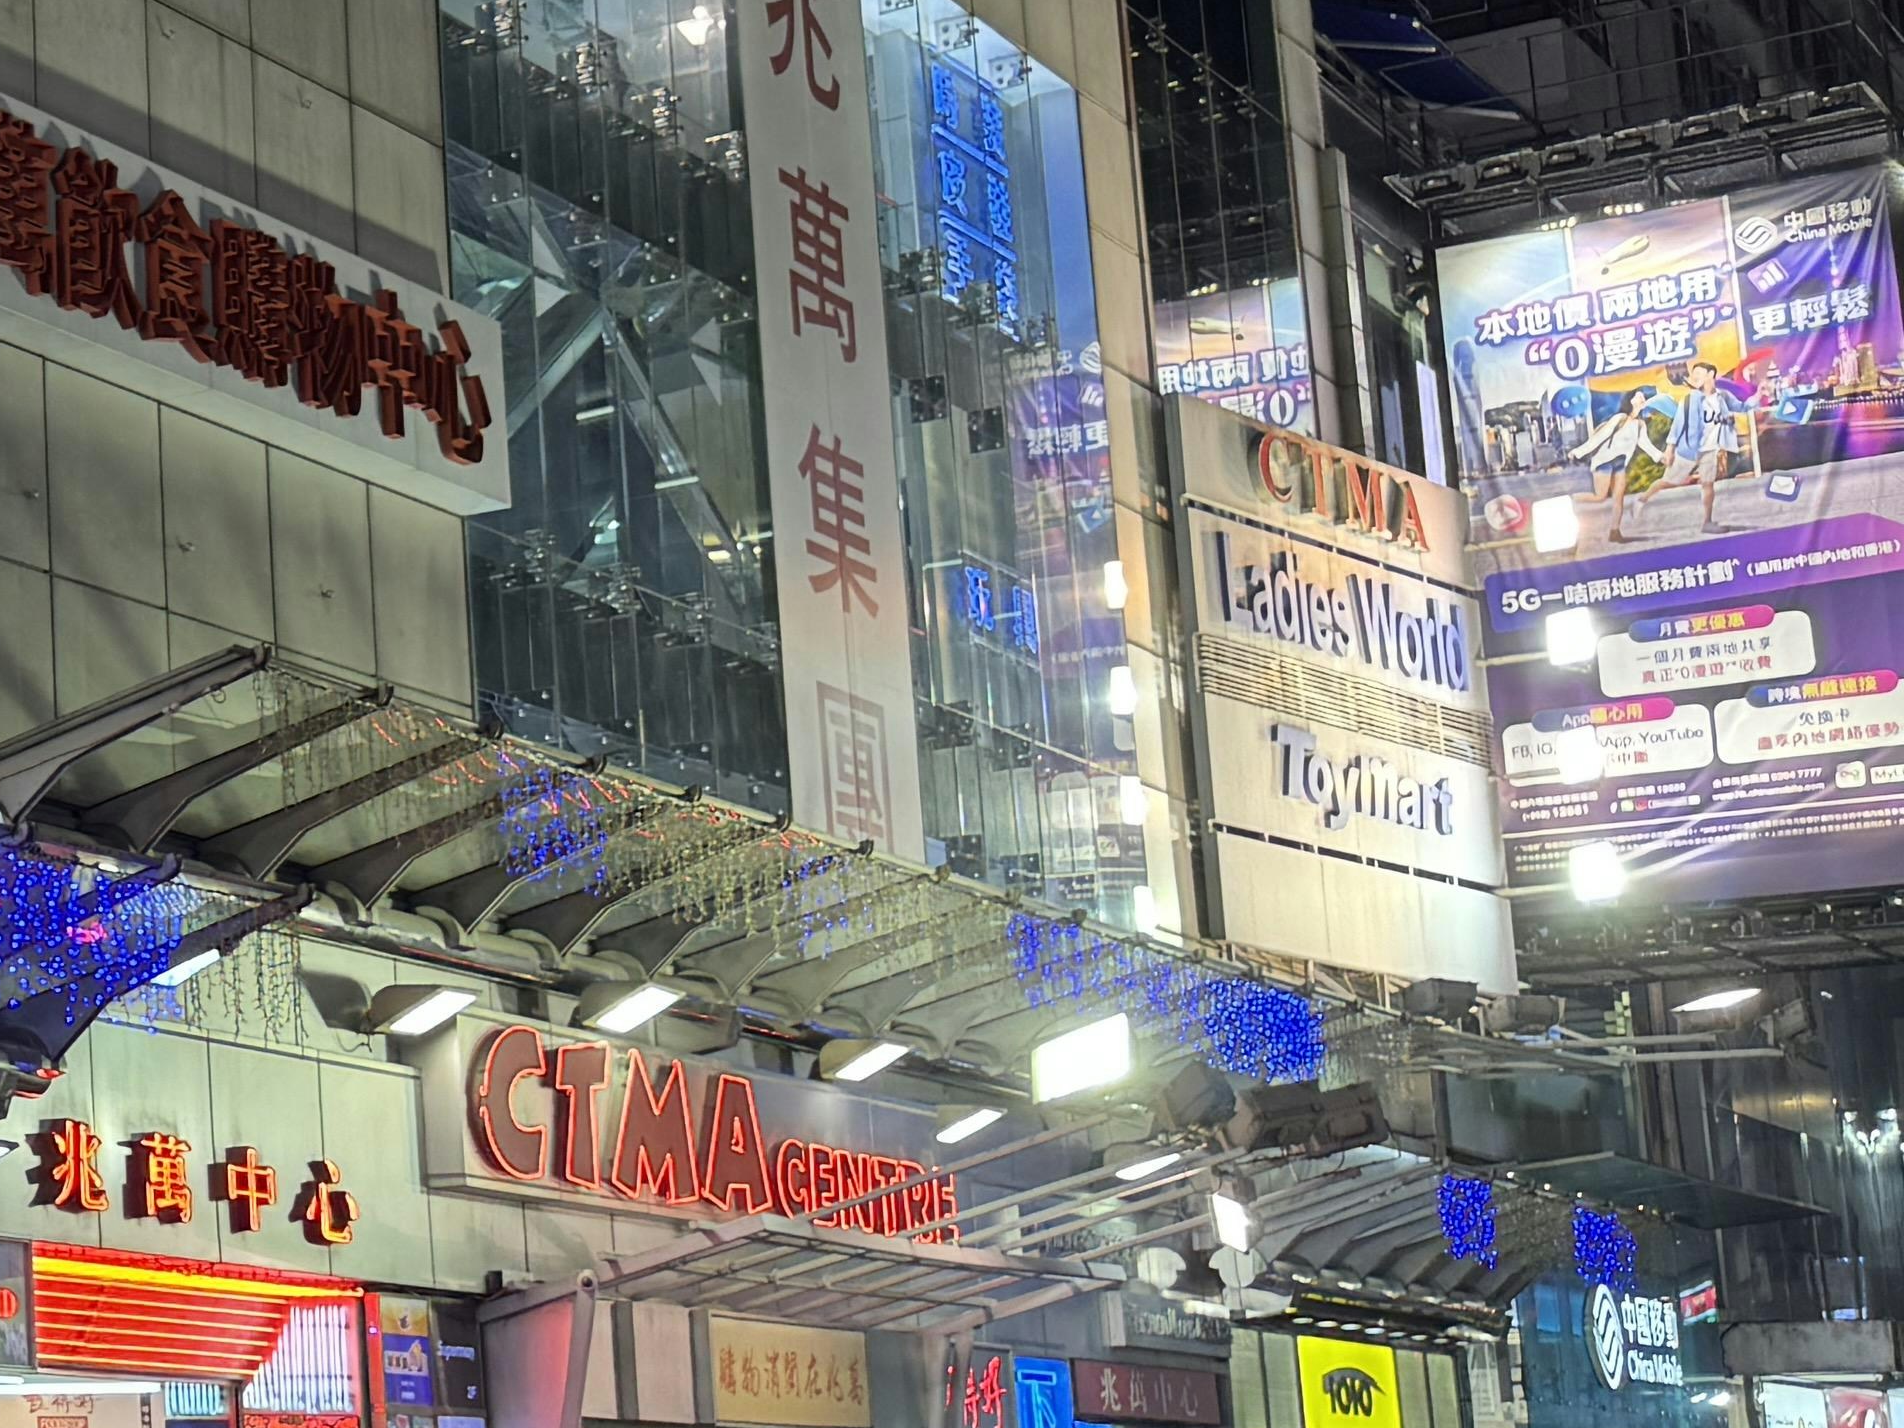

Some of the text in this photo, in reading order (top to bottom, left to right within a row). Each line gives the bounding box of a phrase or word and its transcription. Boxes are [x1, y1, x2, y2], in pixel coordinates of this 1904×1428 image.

[1783, 195, 1872, 231] 中國移動
[1786, 215, 1873, 243] China Mobile
[1748, 284, 1872, 341] 更輕鬆
[1257, 430, 1430, 554] CTMA
[1222, 530, 1469, 693] Ladies World
[478, 1024, 774, 1216] CTMA
[51, 1119, 361, 1245] 兆萬中心
[1627, 1348, 1684, 1387] China Mobile
